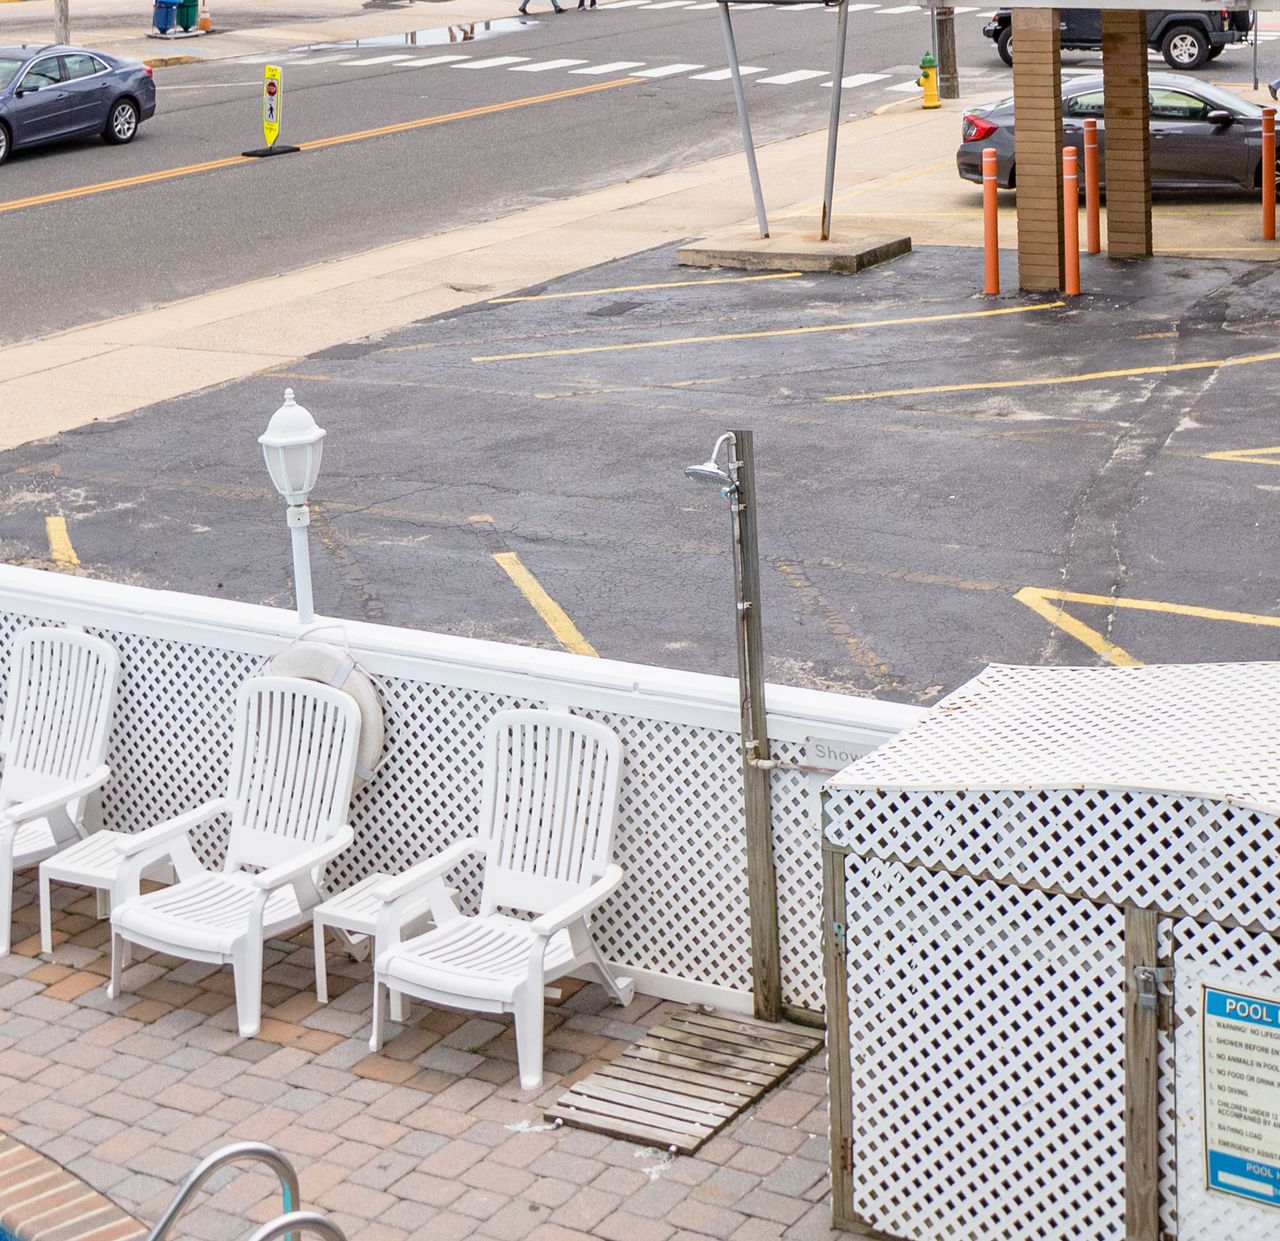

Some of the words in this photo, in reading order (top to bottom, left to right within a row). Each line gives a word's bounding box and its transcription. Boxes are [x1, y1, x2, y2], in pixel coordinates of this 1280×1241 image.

[1225, 998, 1273, 1023] POOL
[1216, 1021, 1248, 1033] WARNING!
[1250, 1028, 1259, 1036] NO
[1216, 1037, 1243, 1048] SHOWER
[1245, 1044, 1269, 1054] BEFORE
[1216, 1053, 1226, 1061] NO
[1227, 1055, 1254, 1067] ANIMALS
[1263, 1063, 1280, 1073] POOL
[1216, 1068, 1226, 1077] NO
[1227, 1071, 1245, 1080] FOOD
[1246, 1074, 1255, 1083] OR
[1256, 1077, 1275, 1088] DRINK
[1217, 1084, 1226, 1092] NO
[1217, 1099, 1248, 1113] CHILDREN
[1249, 1108, 1270, 1118] UNDER
[1217, 1108, 1262, 1124] ACCOMPANIED
[1263, 1118, 1271, 1126] BY
[1218, 1123, 1244, 1136] BATHING
[1245, 1130, 1263, 1141] LOAD
[1218, 1139, 1255, 1154] EMERGENCY
[1246, 1162, 1274, 1179] POOL
